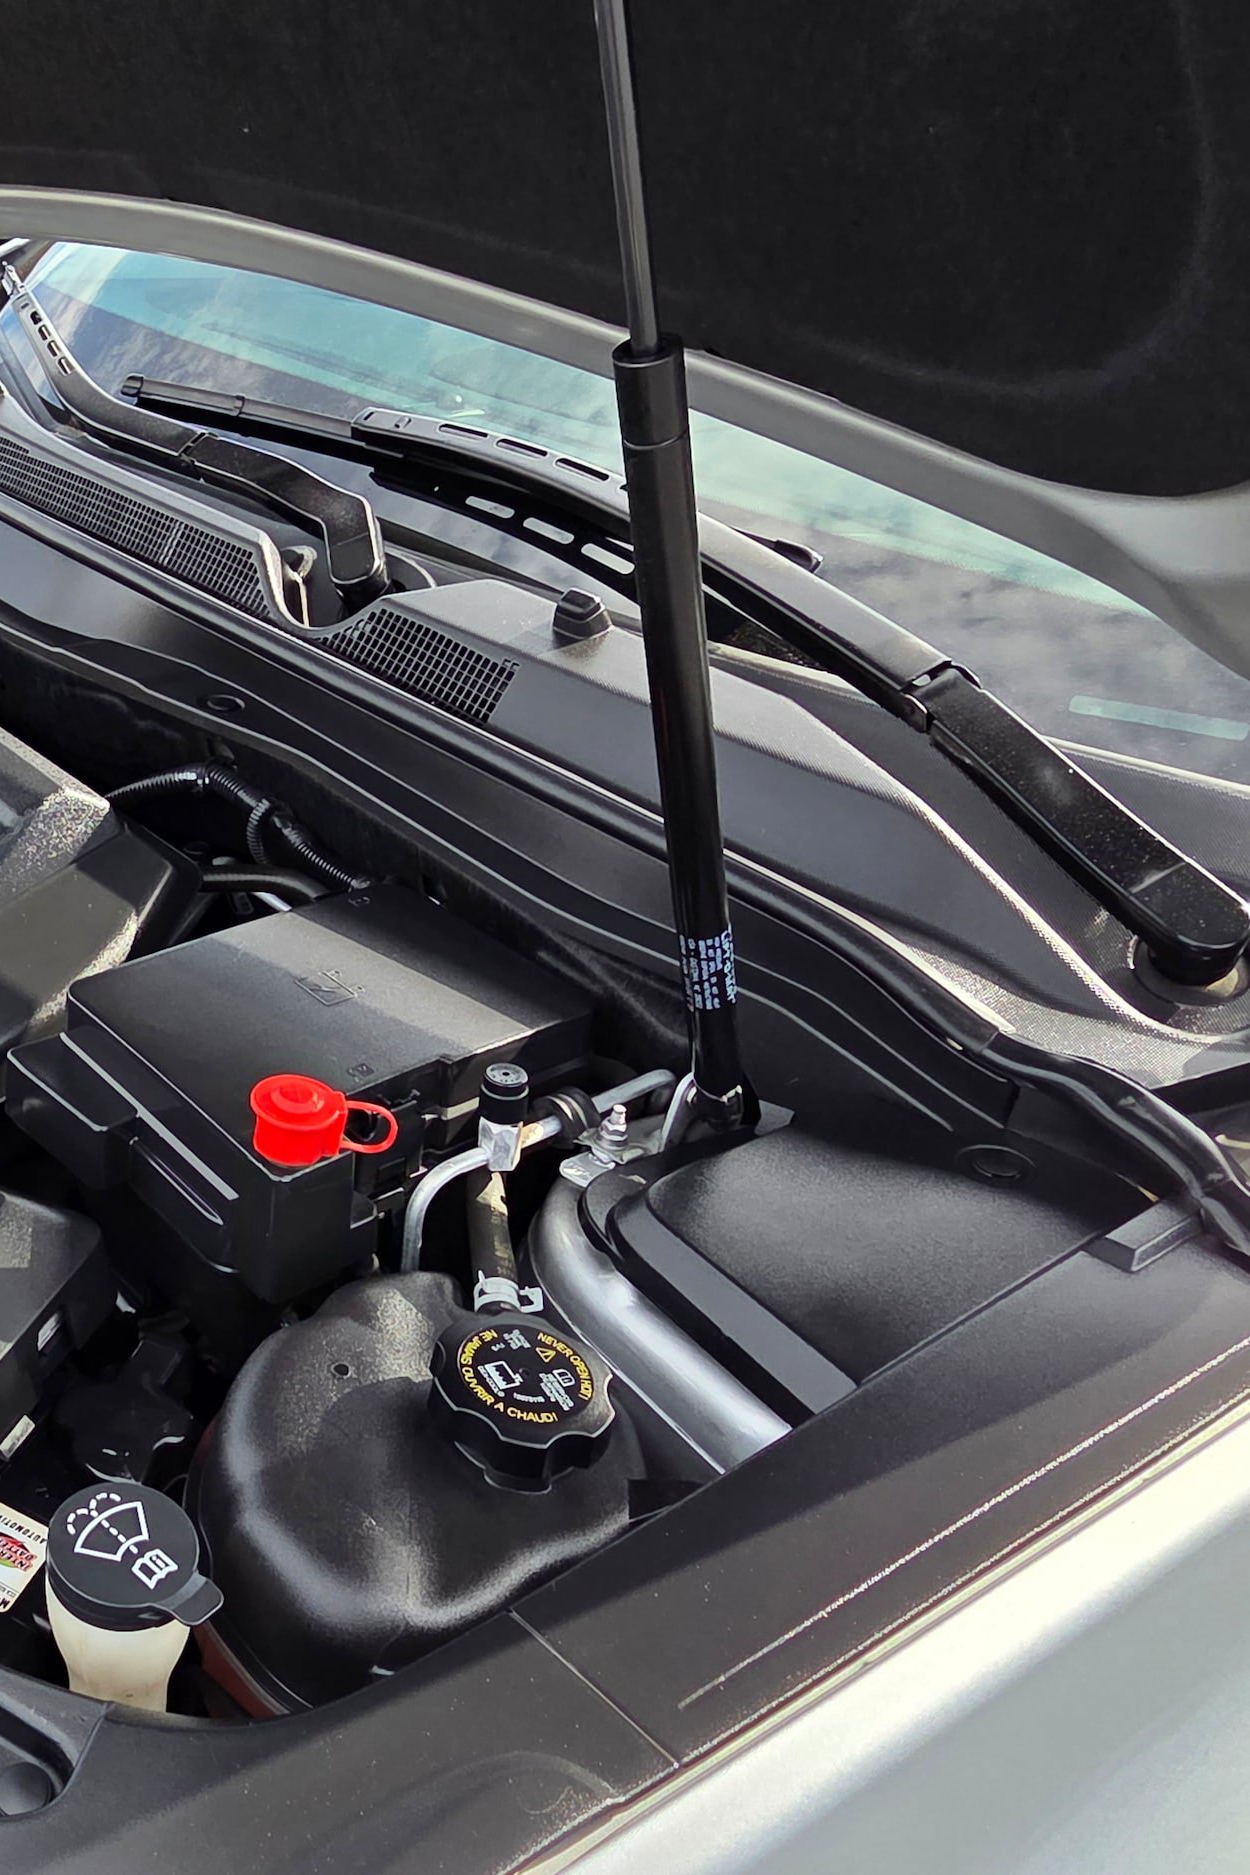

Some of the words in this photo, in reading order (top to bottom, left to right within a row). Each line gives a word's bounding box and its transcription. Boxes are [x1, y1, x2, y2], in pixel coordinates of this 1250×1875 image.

[479, 1329, 498, 1343] NE
[538, 1332, 573, 1358] NEVER
[570, 1355, 591, 1380] OPEN
[462, 1367, 495, 1406] OUVRIR
